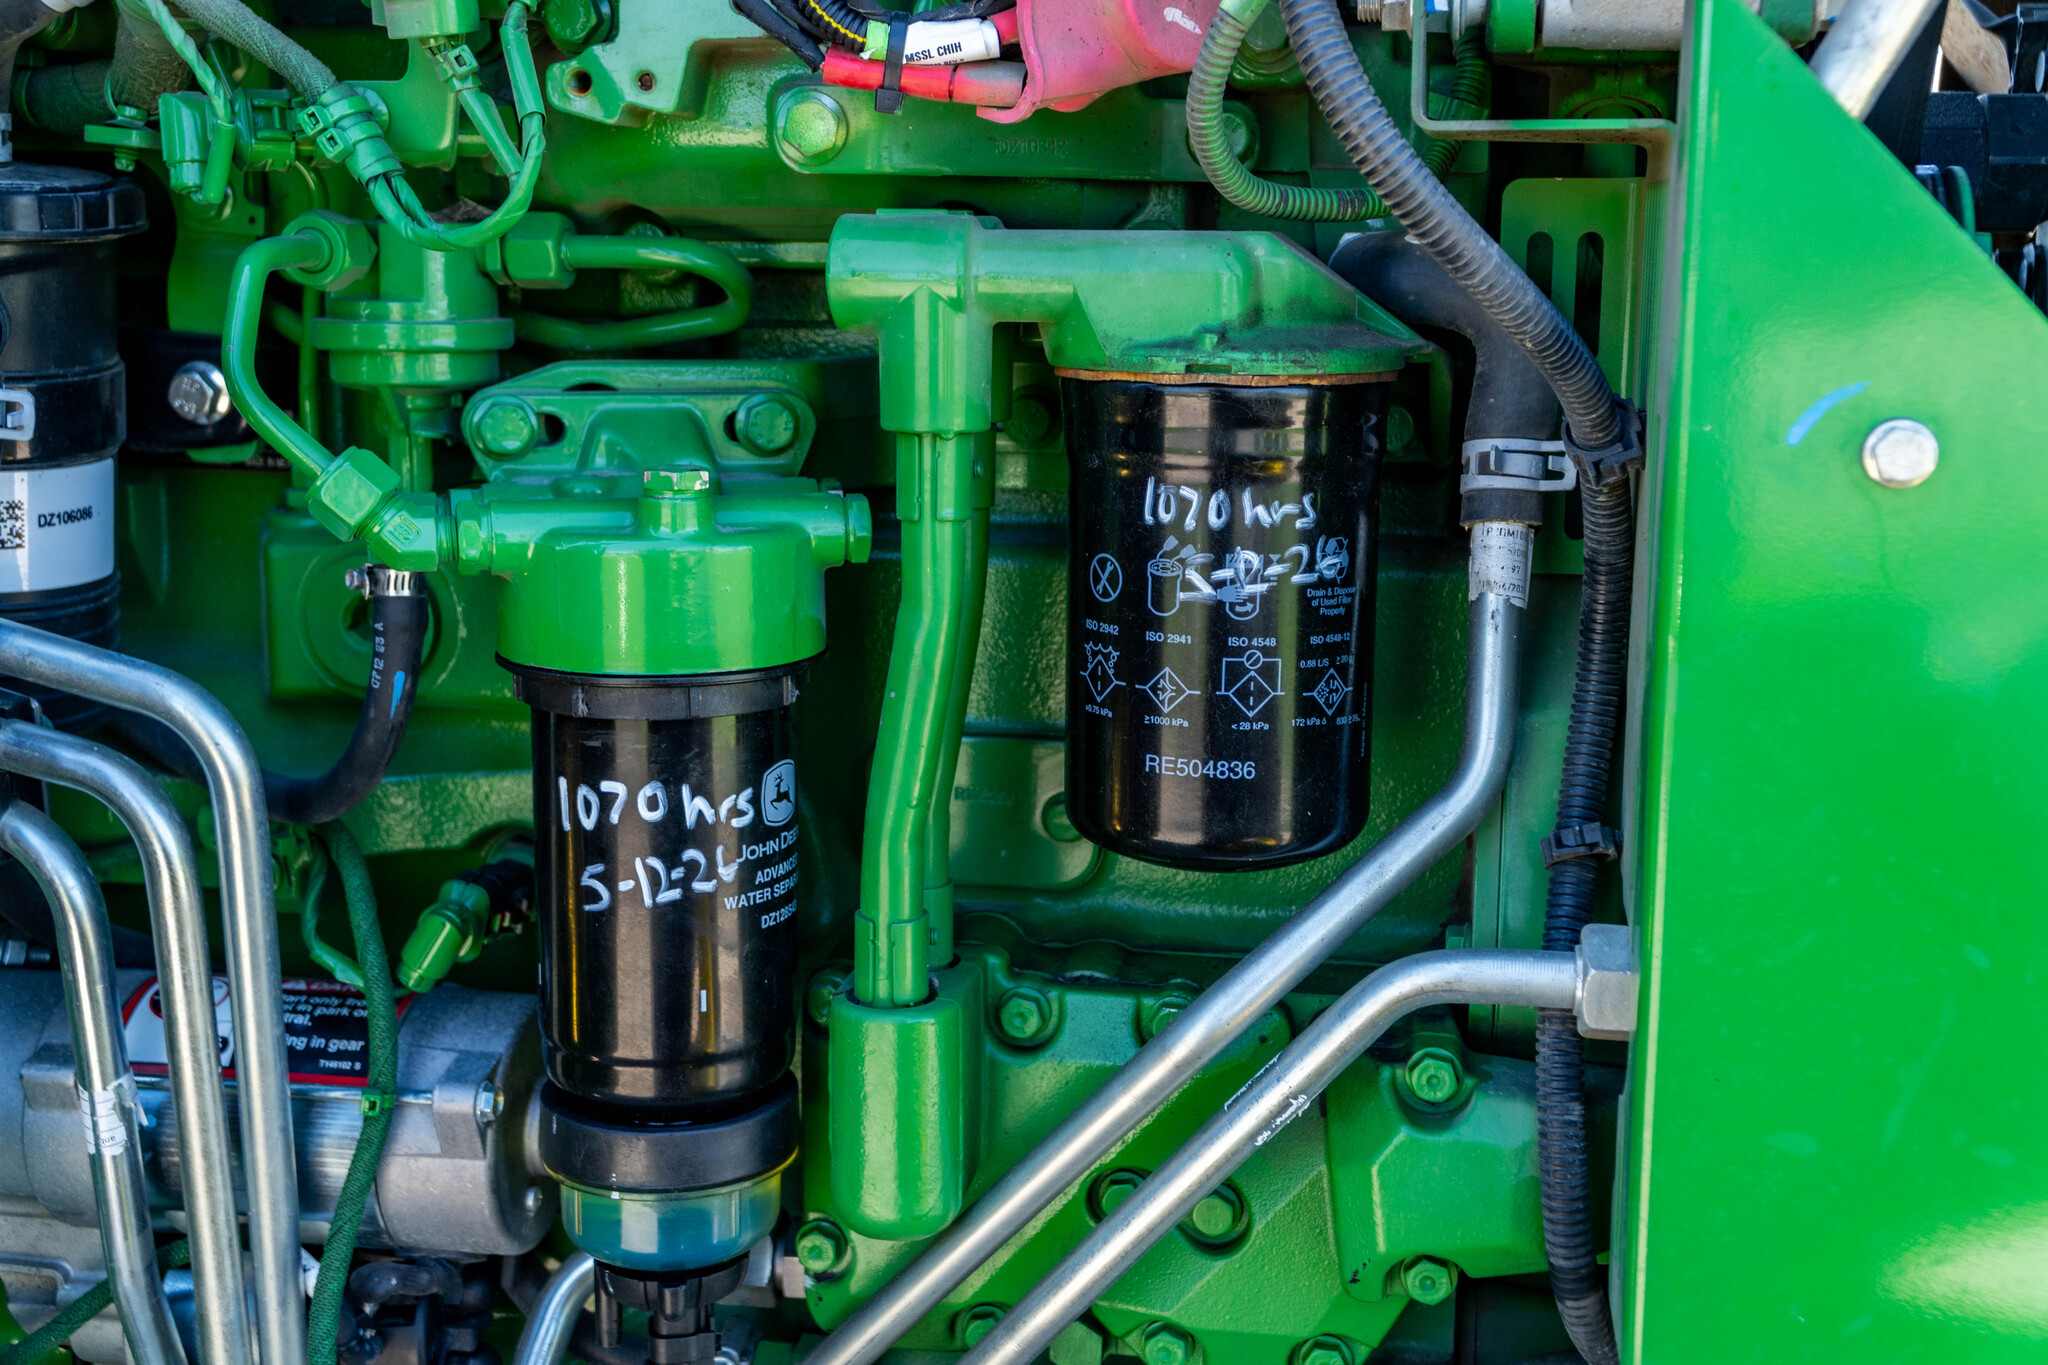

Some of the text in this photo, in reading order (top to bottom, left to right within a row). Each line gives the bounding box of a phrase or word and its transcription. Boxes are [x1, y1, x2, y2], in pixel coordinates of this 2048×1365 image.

[905, 48, 935, 63] MSSL
[936, 41, 963, 57] CHIH
[1143, 476, 1317, 532] 1070 hrs
[37, 506, 93, 528] DZ106086
[1307, 588, 1326, 597] Drain
[1327, 587, 1333, 596] &
[1311, 599, 1319, 607] of
[1320, 596, 1338, 606] Used
[1320, 606, 1346, 616] Properly
[1086, 618, 1119, 636] ISO 2942
[1146, 631, 1192, 645] ISO 2941
[1228, 637, 1277, 647] ISO 4548
[1310, 632, 1350, 645] ISO 4548-12
[1300, 659, 1317, 669] 0.88
[1318, 657, 1330, 668] L/S
[1101, 707, 1113, 718] kPa
[1172, 717, 1189, 728] kPa
[1239, 722, 1250, 730] 28
[1251, 721, 1270, 731] kPa
[1292, 719, 1305, 727] 172
[1306, 717, 1320, 727] kPa
[1145, 754, 1256, 780] RE504836
[558, 776, 755, 832] 1070 hrs
[736, 838, 780, 863] JOHN
[724, 886, 772, 911] WATER
[309, 997, 343, 1007] only
[314, 1007, 350, 1017] park
[310, 1035, 326, 1049] in
[328, 1039, 364, 1053] gear
